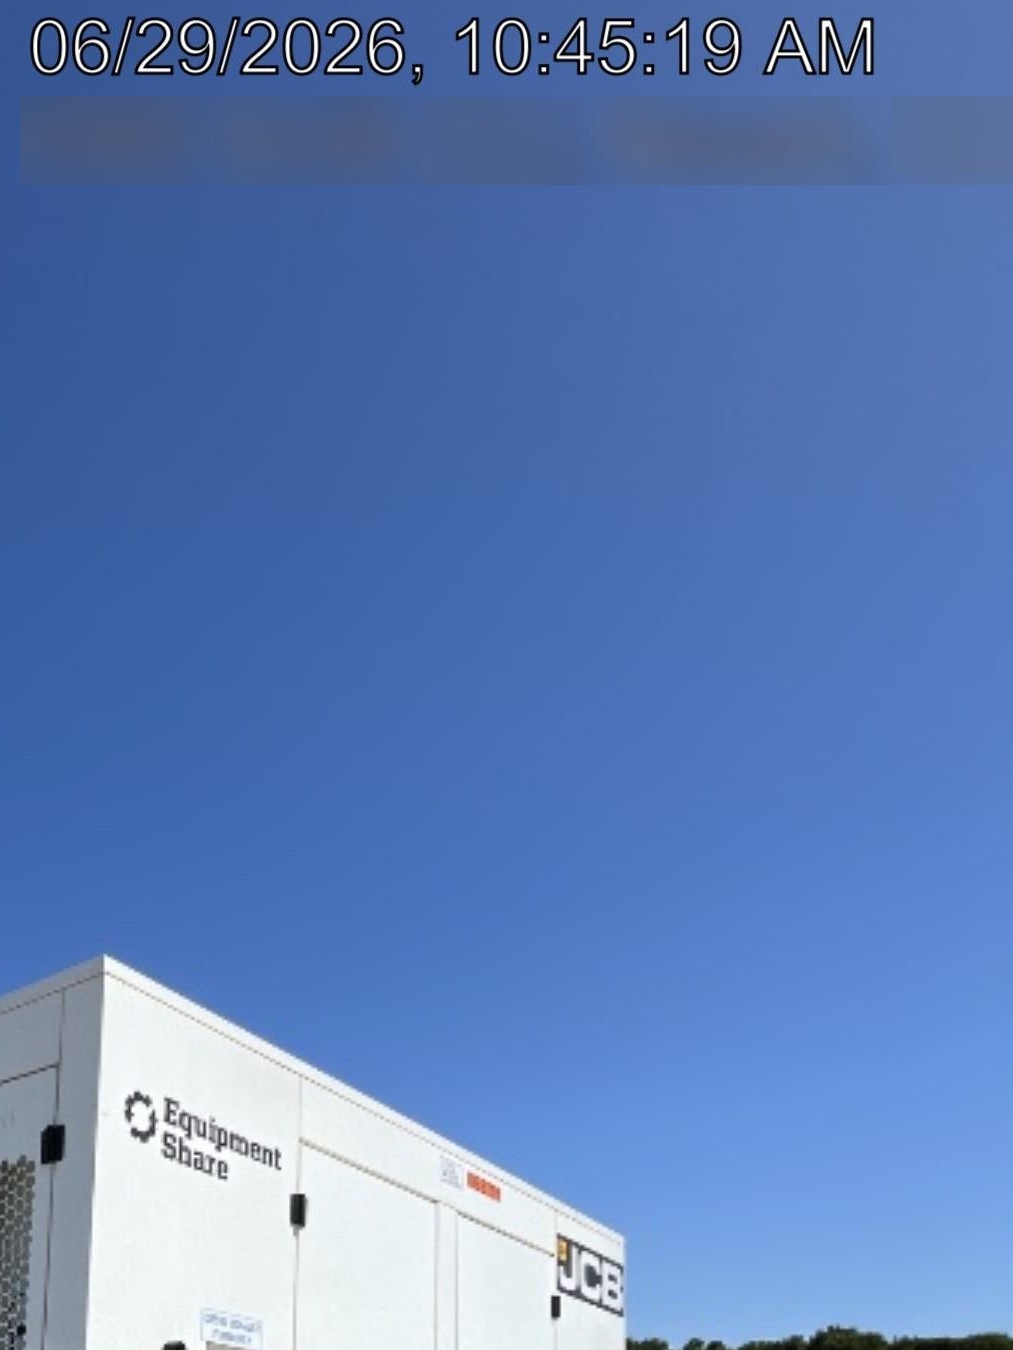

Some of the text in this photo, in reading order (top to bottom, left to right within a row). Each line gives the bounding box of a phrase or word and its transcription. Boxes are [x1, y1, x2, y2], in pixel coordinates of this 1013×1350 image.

[161, 1131, 229, 1181] Share
[163, 1097, 282, 1171] Equipment
[558, 1240, 624, 1315] JCB
